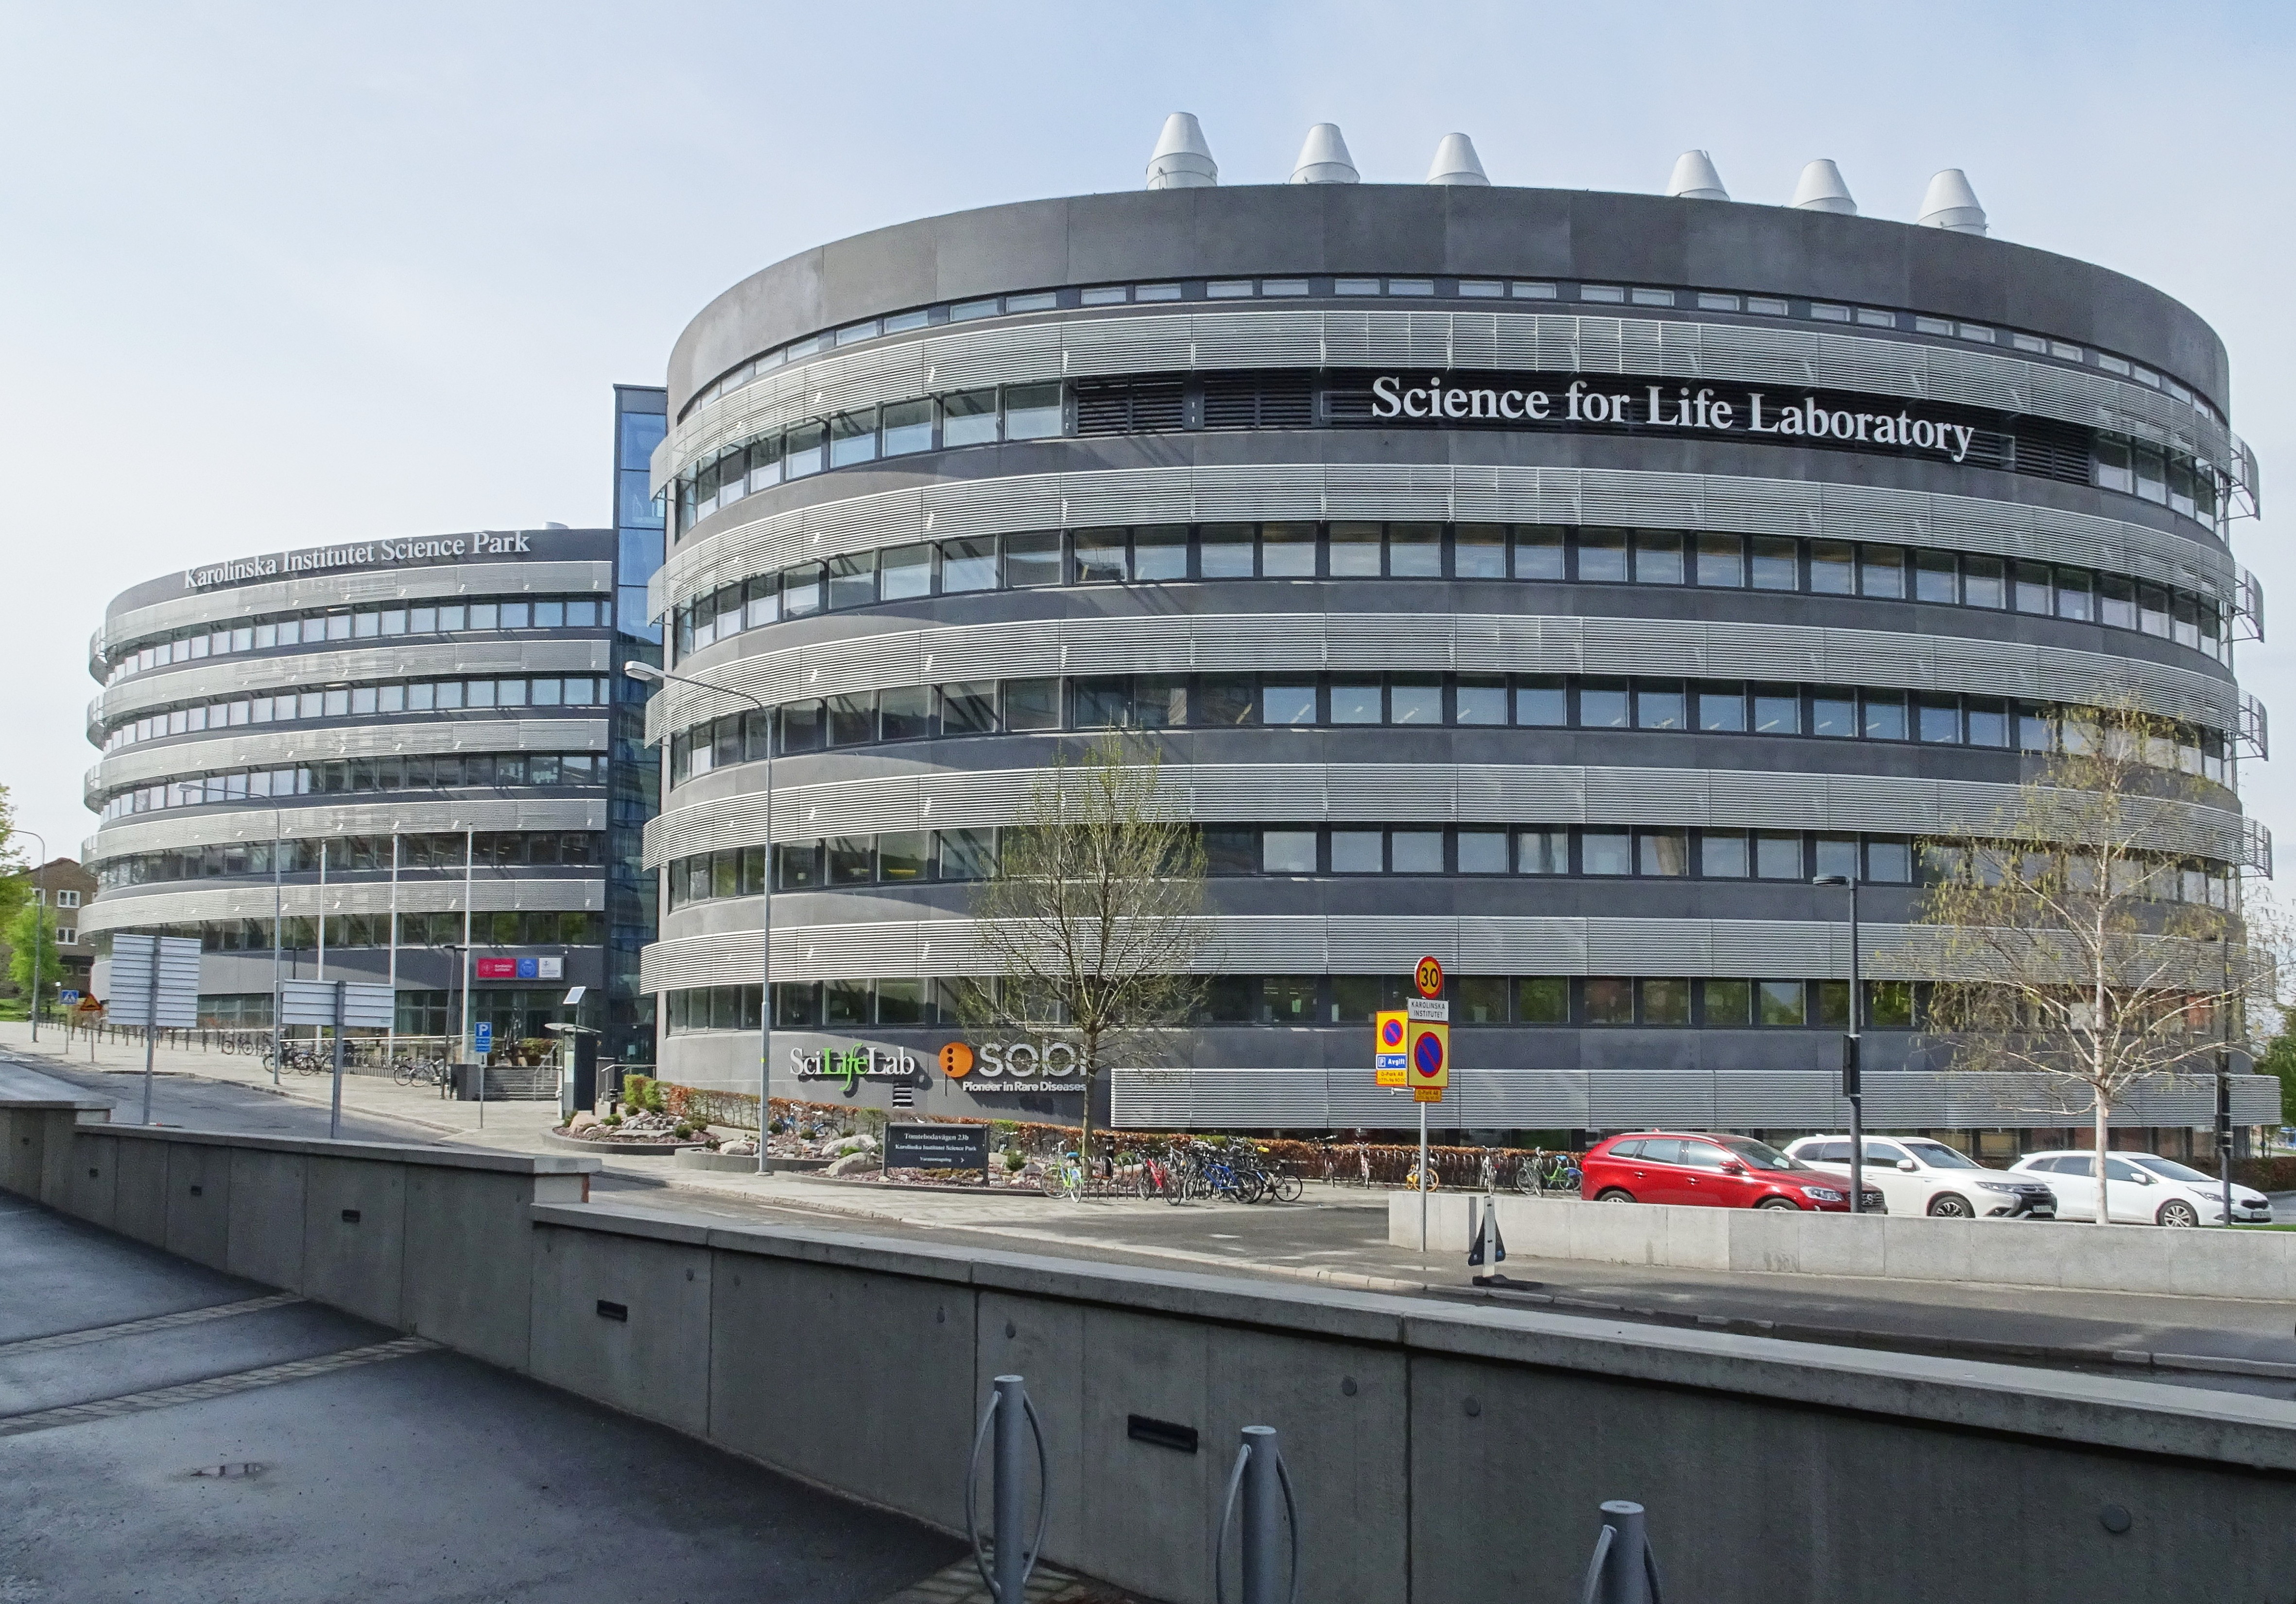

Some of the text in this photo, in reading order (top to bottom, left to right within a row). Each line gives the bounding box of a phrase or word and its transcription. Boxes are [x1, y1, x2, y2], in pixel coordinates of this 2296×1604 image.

[1371, 376, 1975, 463] Science for Life Laboratory
[185, 531, 531, 589] Karolinska Institutet Science Park
[1421, 967, 1438, 988] 30
[1411, 1001, 1445, 1010] KAROLINSKA
[1413, 1010, 1443, 1018] INSTITUTET
[479, 1024, 489, 1036] P
[789, 1043, 915, 1092] SciLifeLab
[963, 1081, 1087, 1092] Pioneer in Rare Diseases
[904, 1133, 956, 1141] Tomtebodavägen
